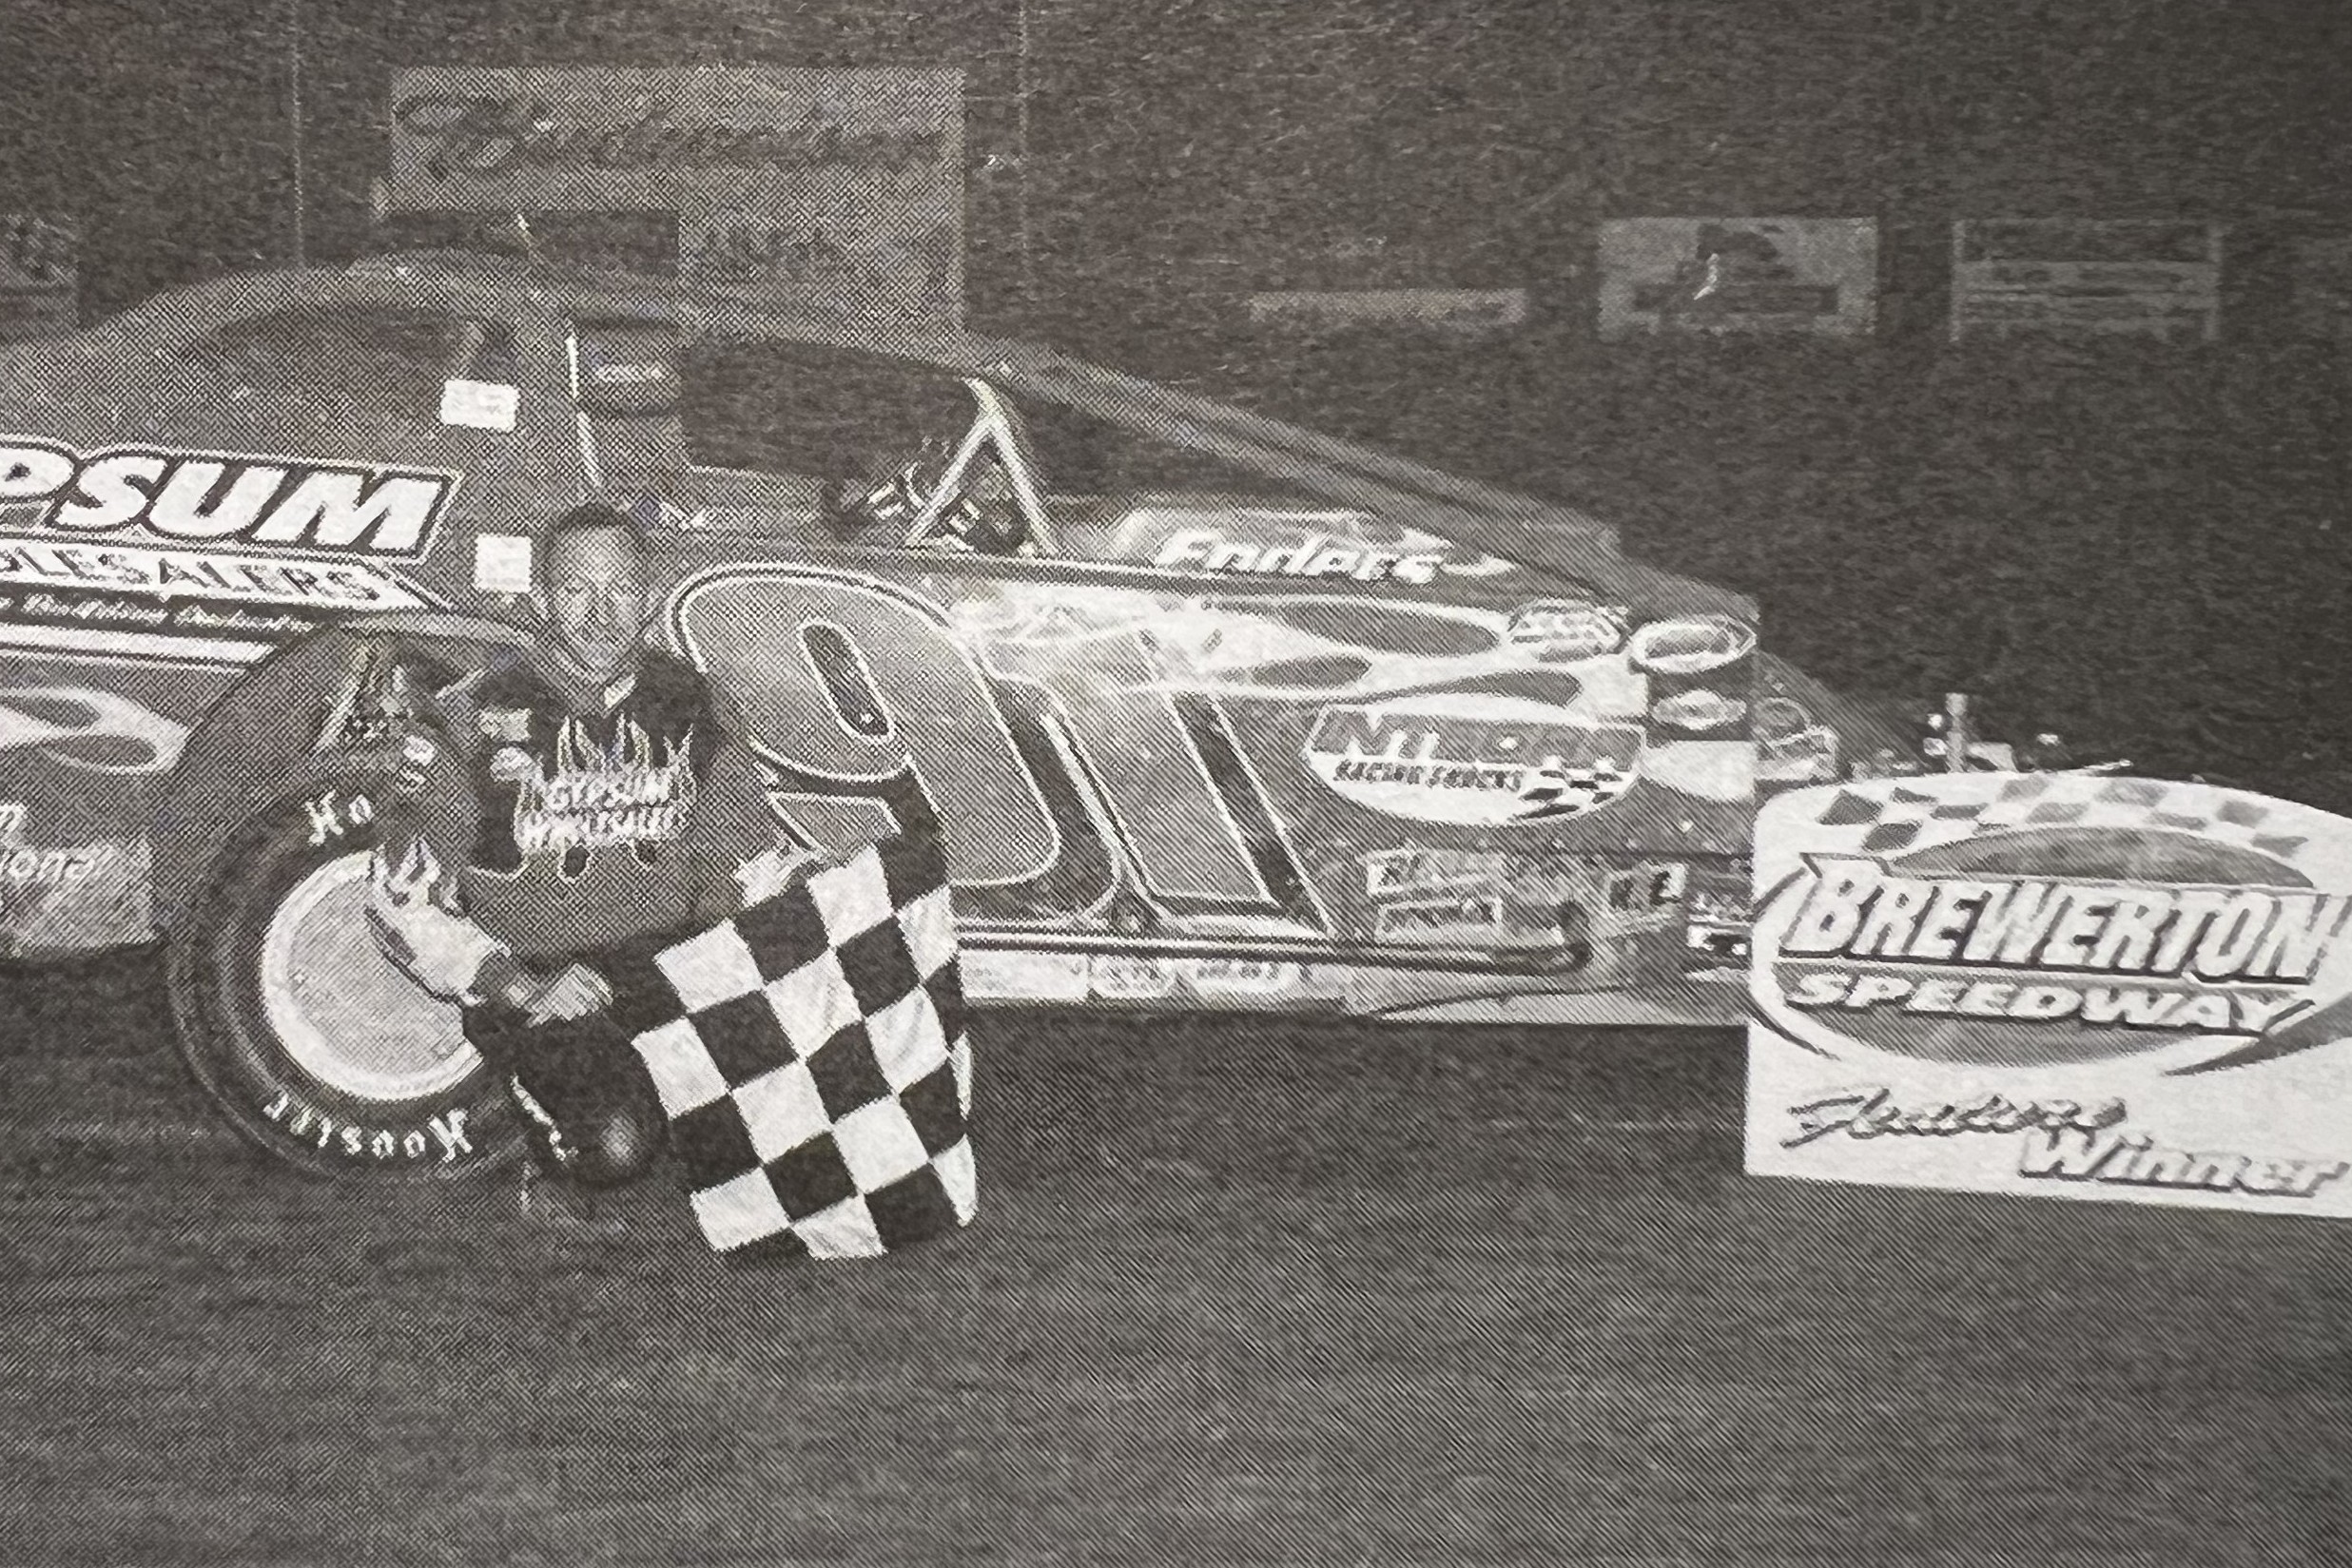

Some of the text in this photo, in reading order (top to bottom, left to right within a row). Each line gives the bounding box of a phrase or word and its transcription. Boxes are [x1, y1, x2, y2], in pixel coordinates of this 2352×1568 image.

[0, 447, 443, 551] PSUM
[1777, 856, 2352, 983] BREWERTON
[1787, 970, 2314, 1037] SPEEDWAY
[2016, 1130, 2351, 1198] Winner
